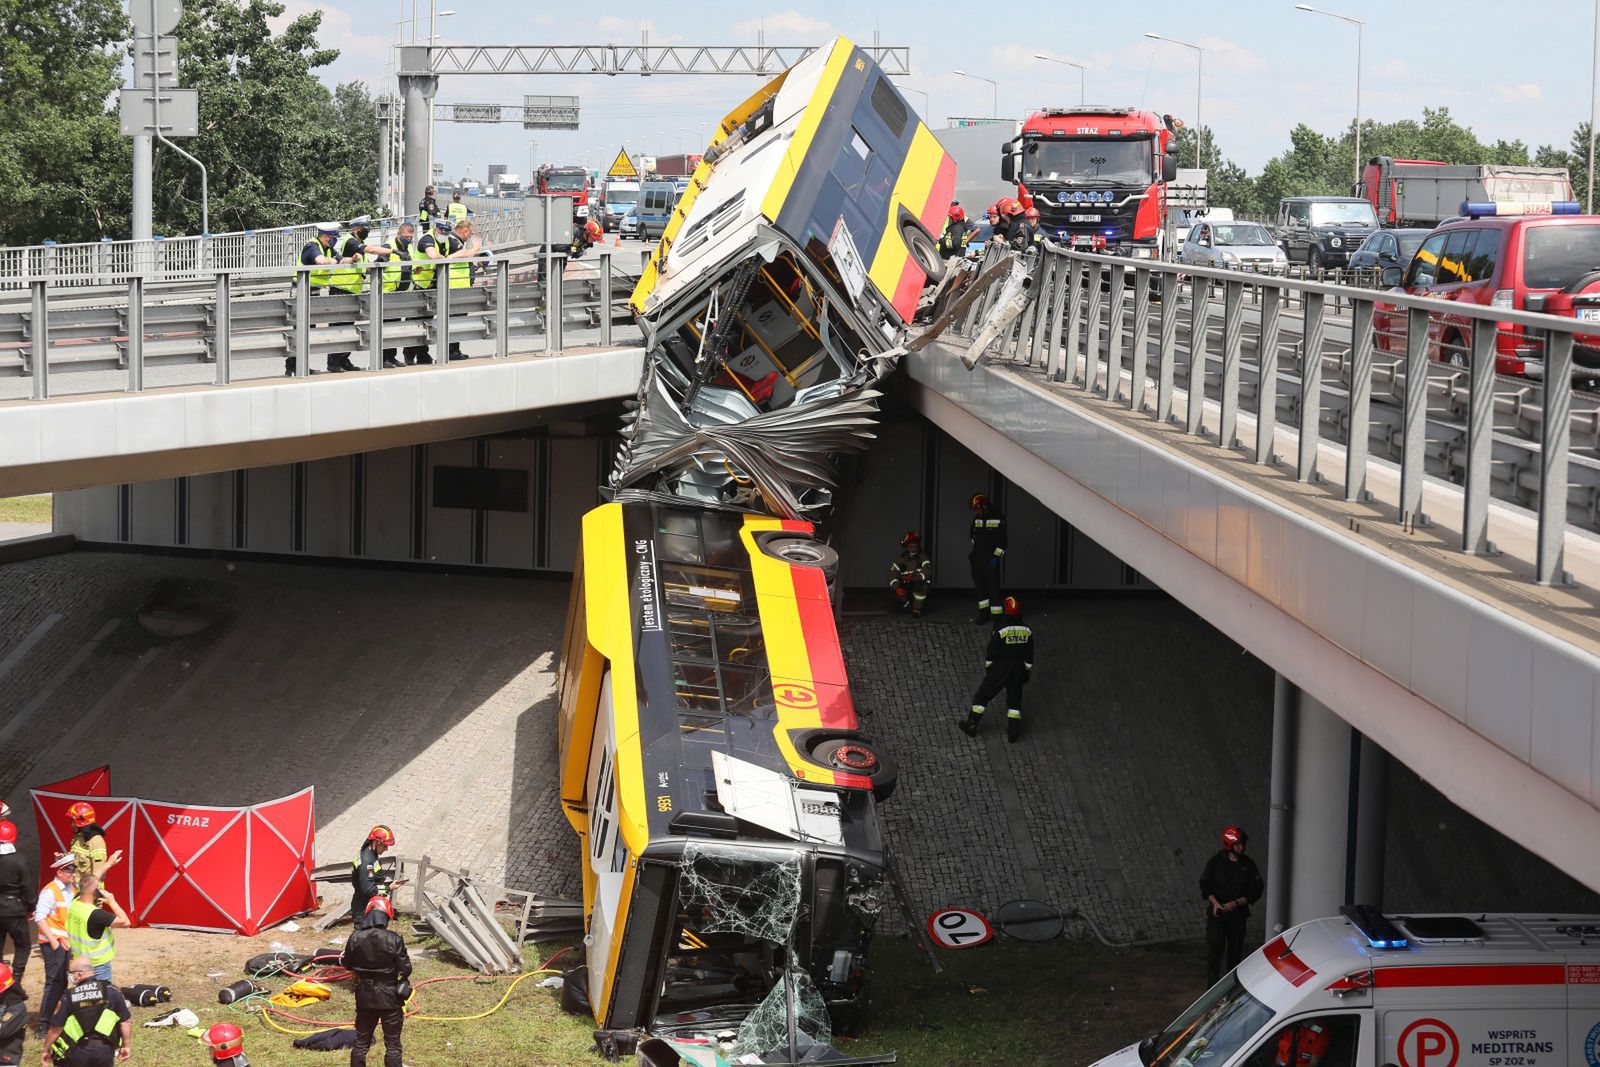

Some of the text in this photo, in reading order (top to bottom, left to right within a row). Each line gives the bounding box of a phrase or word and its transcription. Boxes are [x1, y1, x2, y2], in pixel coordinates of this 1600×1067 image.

[635, 539, 649, 554] CNG
[638, 561, 655, 602] ekologiczny
[642, 604, 658, 629] jestem
[657, 795, 673, 812] 9931
[938, 912, 981, 945] 70
[71, 990, 103, 1003] MIEJSKA
[1471, 1042, 1553, 1054] MEDITRANS
[1489, 1057, 1502, 1066] SP
[1504, 1057, 1525, 1066] ZOZ
